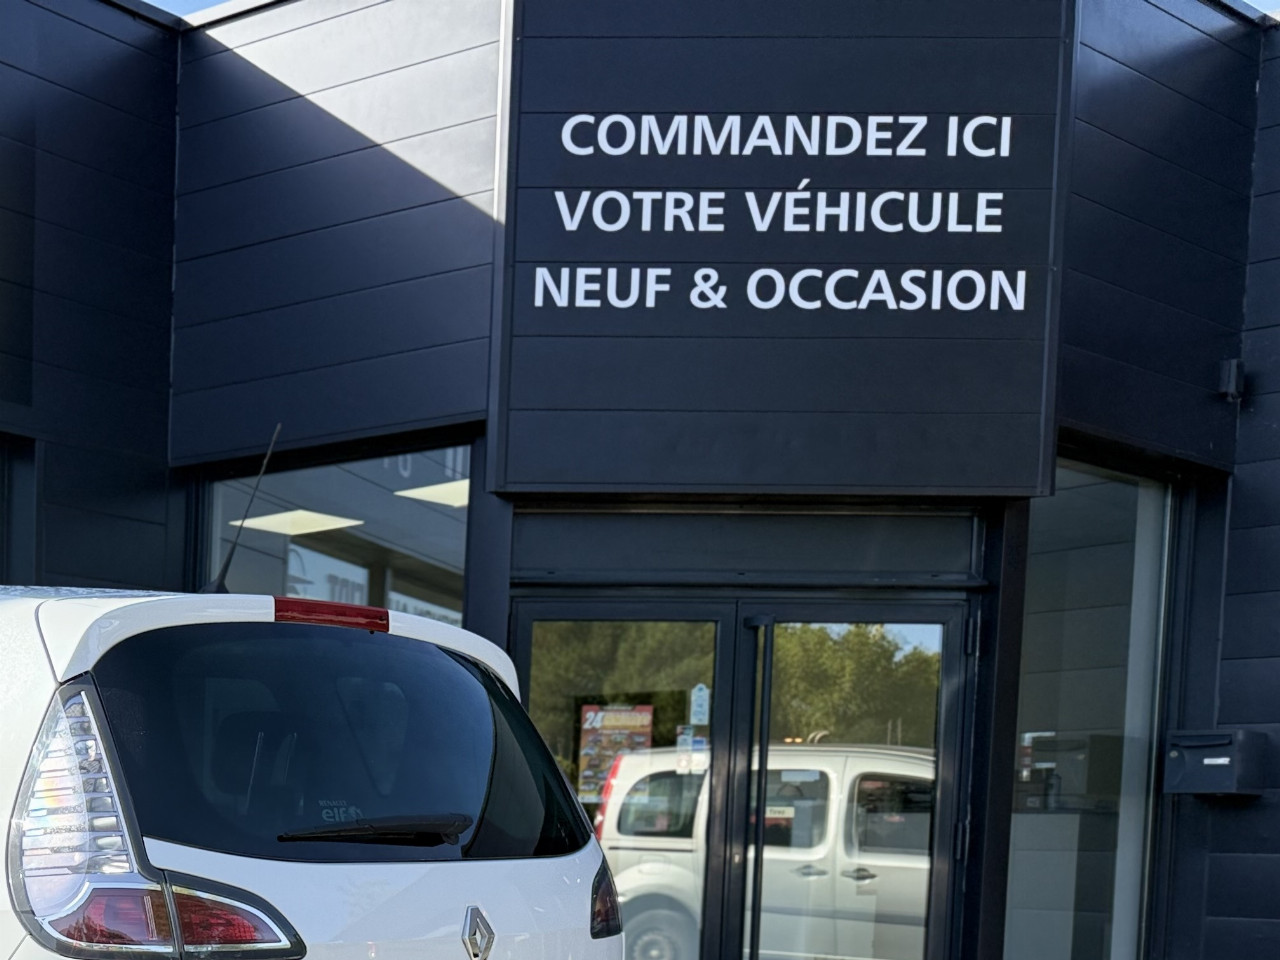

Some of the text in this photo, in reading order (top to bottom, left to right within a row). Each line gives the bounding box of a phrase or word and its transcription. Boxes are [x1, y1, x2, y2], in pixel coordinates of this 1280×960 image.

[561, 114, 1012, 158] COMMANDEZ ICI
[554, 179, 1004, 233] VOTRE VÉHICULE
[534, 267, 1026, 311] NEUF & OCCASION
[321, 807, 347, 822] elf
